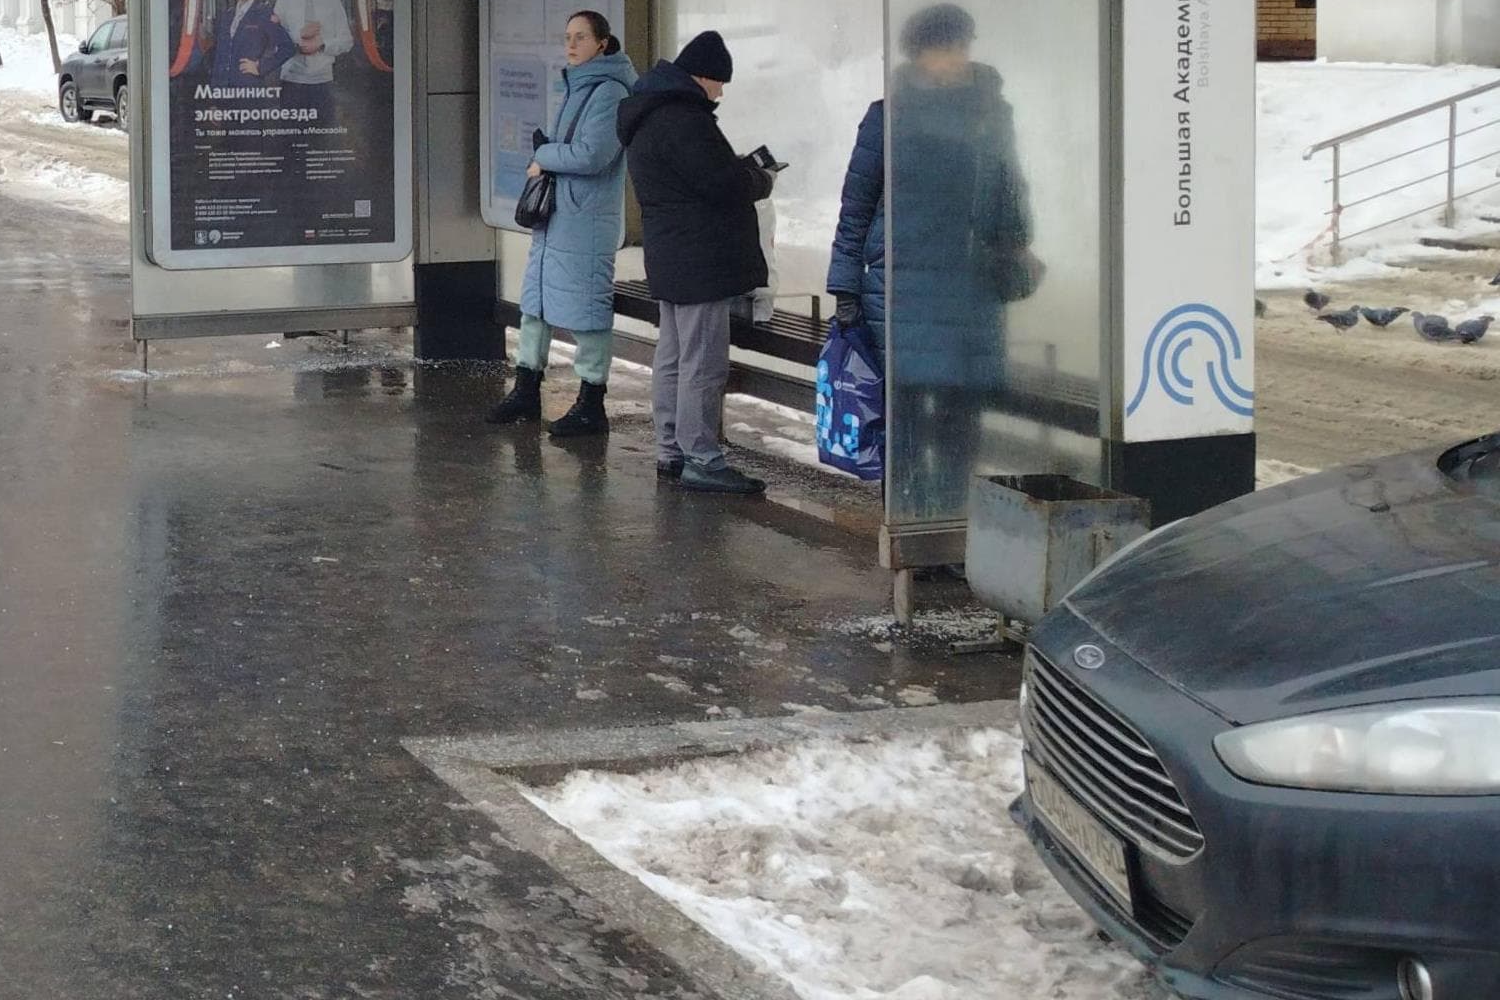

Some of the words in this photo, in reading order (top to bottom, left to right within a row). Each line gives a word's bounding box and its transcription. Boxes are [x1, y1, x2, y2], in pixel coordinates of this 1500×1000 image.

[1196, 11, 1213, 88] Bolshaya
[194, 84, 282, 99] Машинист
[194, 108, 318, 123] электропоезда
[195, 128, 204, 136] Ты
[206, 128, 226, 136] тоже
[262, 128, 302, 137] управлять
[1173, 111, 1192, 227] Большая
